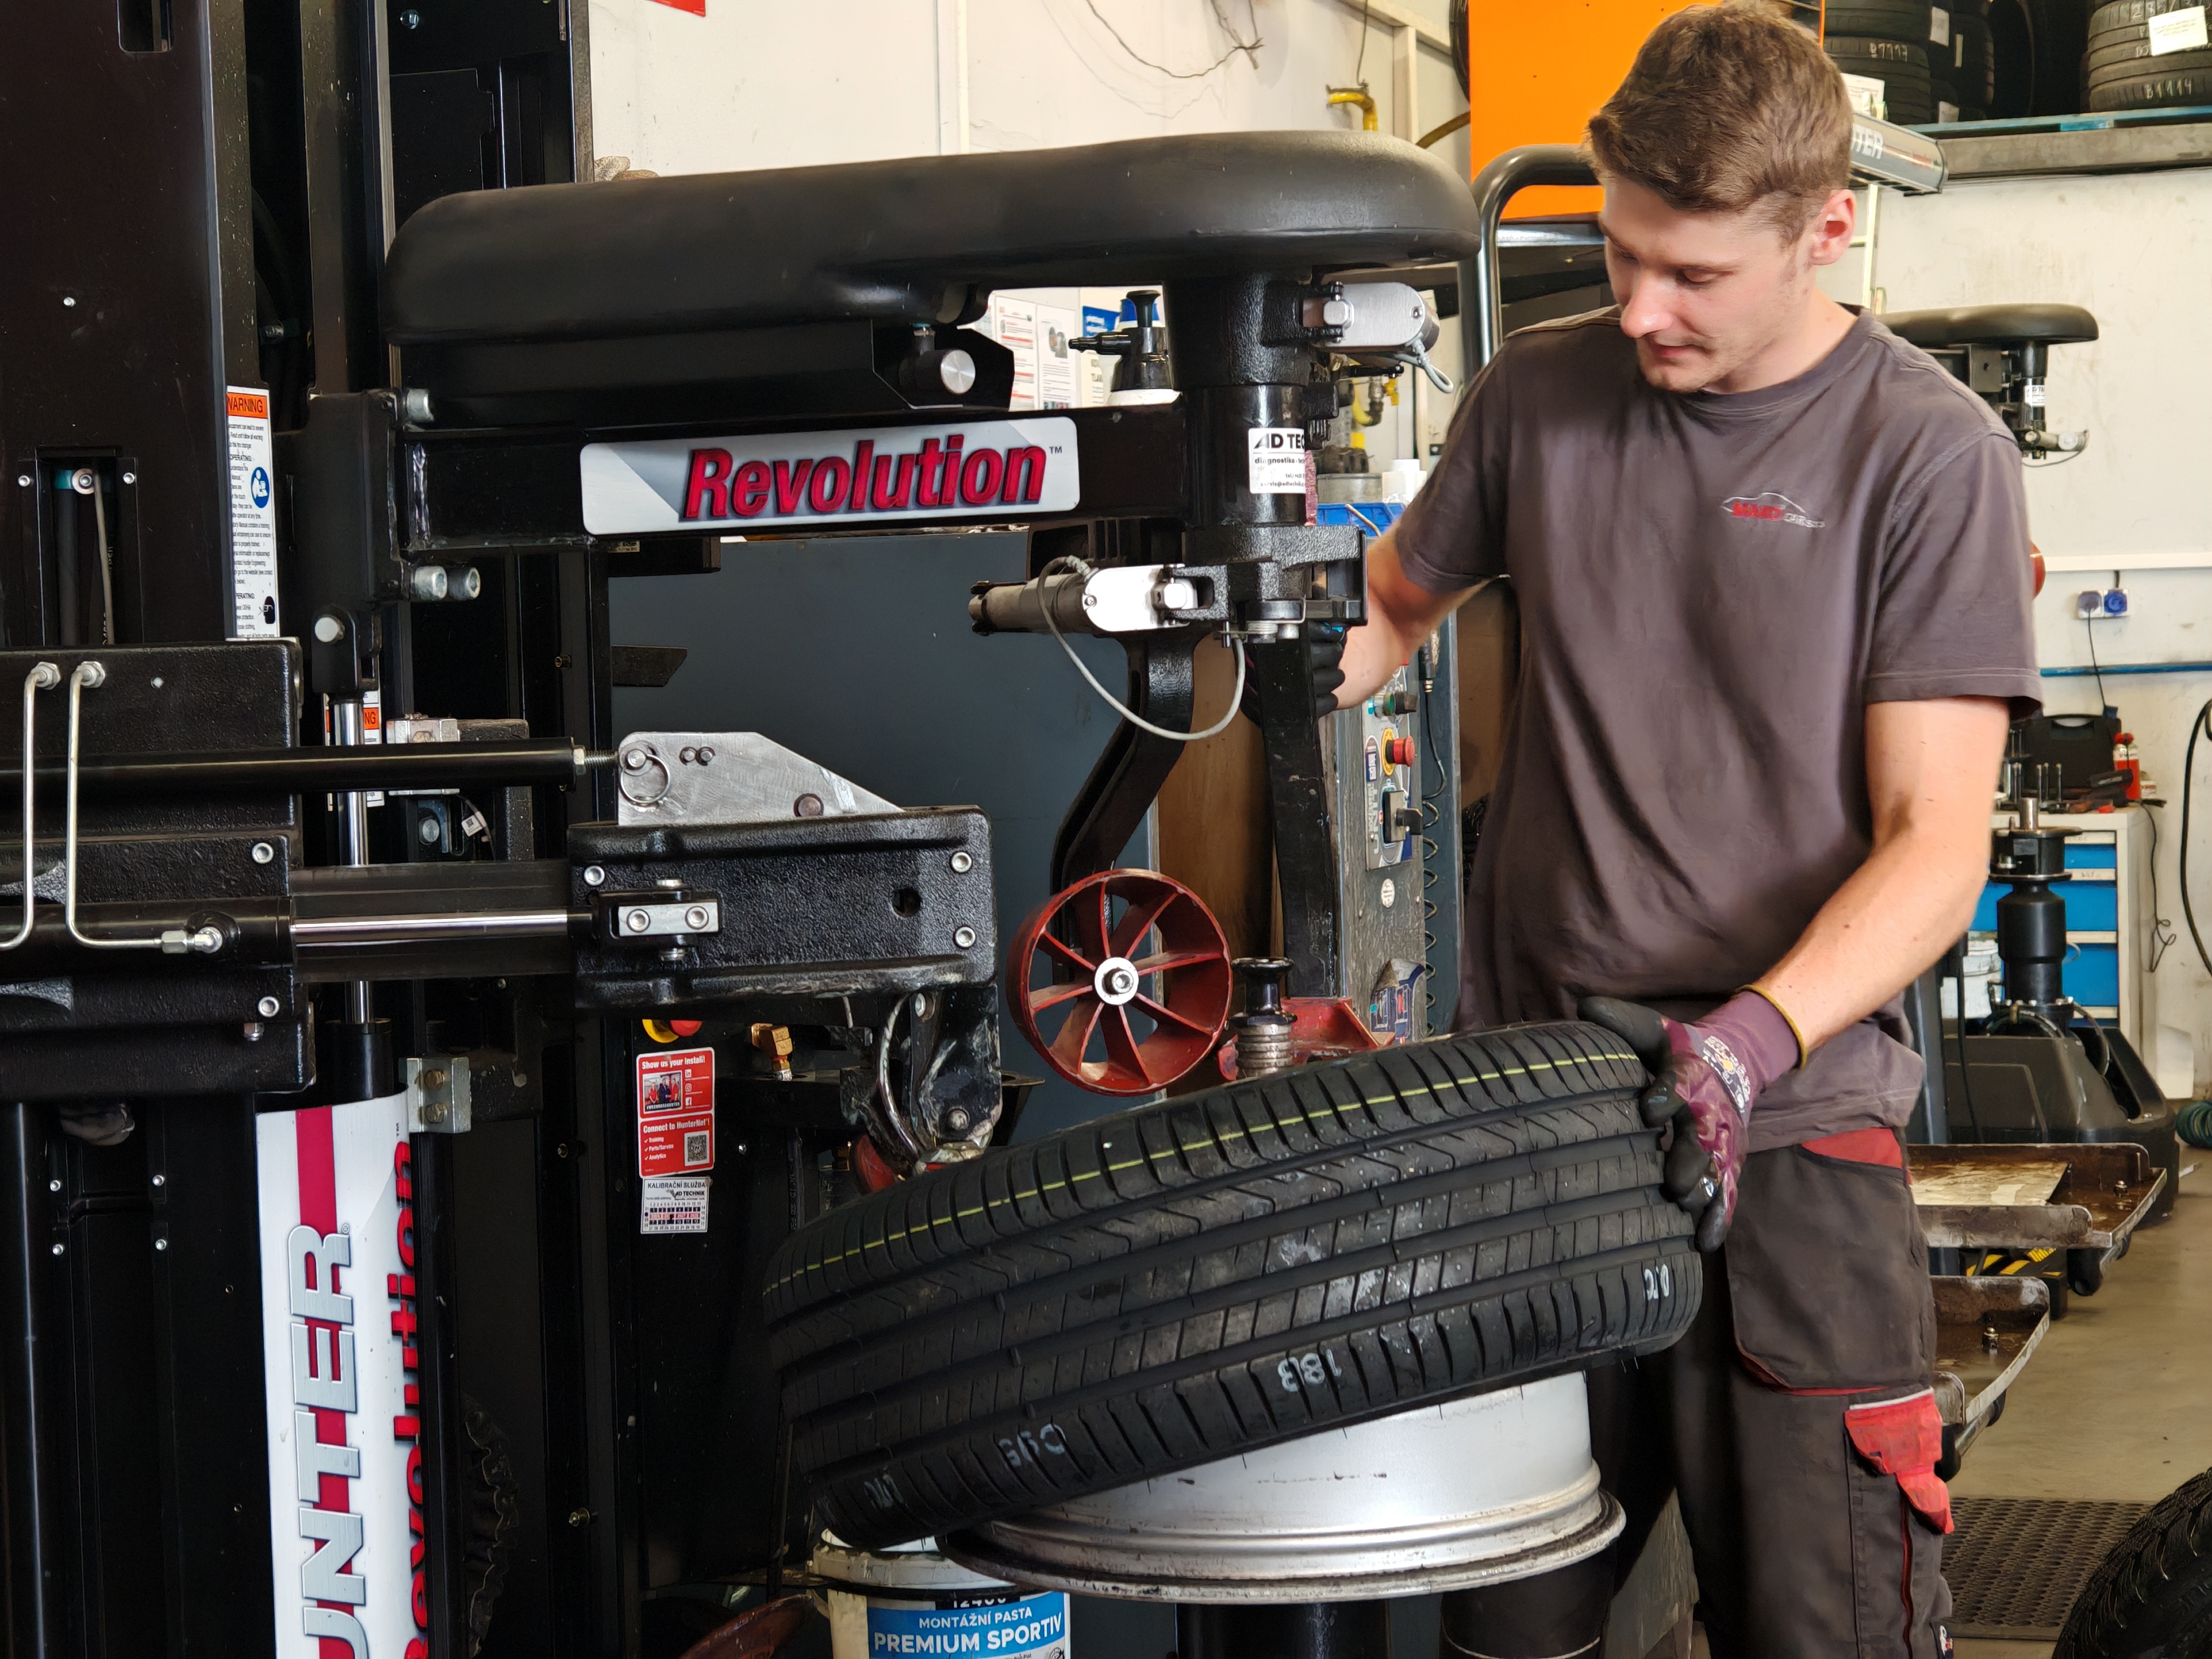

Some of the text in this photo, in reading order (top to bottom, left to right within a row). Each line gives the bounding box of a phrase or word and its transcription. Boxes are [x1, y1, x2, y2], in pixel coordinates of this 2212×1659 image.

[1253, 433, 1284, 449] AD
[683, 434, 1047, 520] Revolution
[642, 1061, 659, 1070] Show
[669, 1059, 683, 1068] your
[643, 1123, 667, 1133] Connect
[648, 1181, 682, 1189] KALIBRAČNÍ
[919, 1607, 1032, 1629] MONTÁŽNÍ PASTA
[874, 1612, 1062, 1654] PREMIUM SPORTIV
